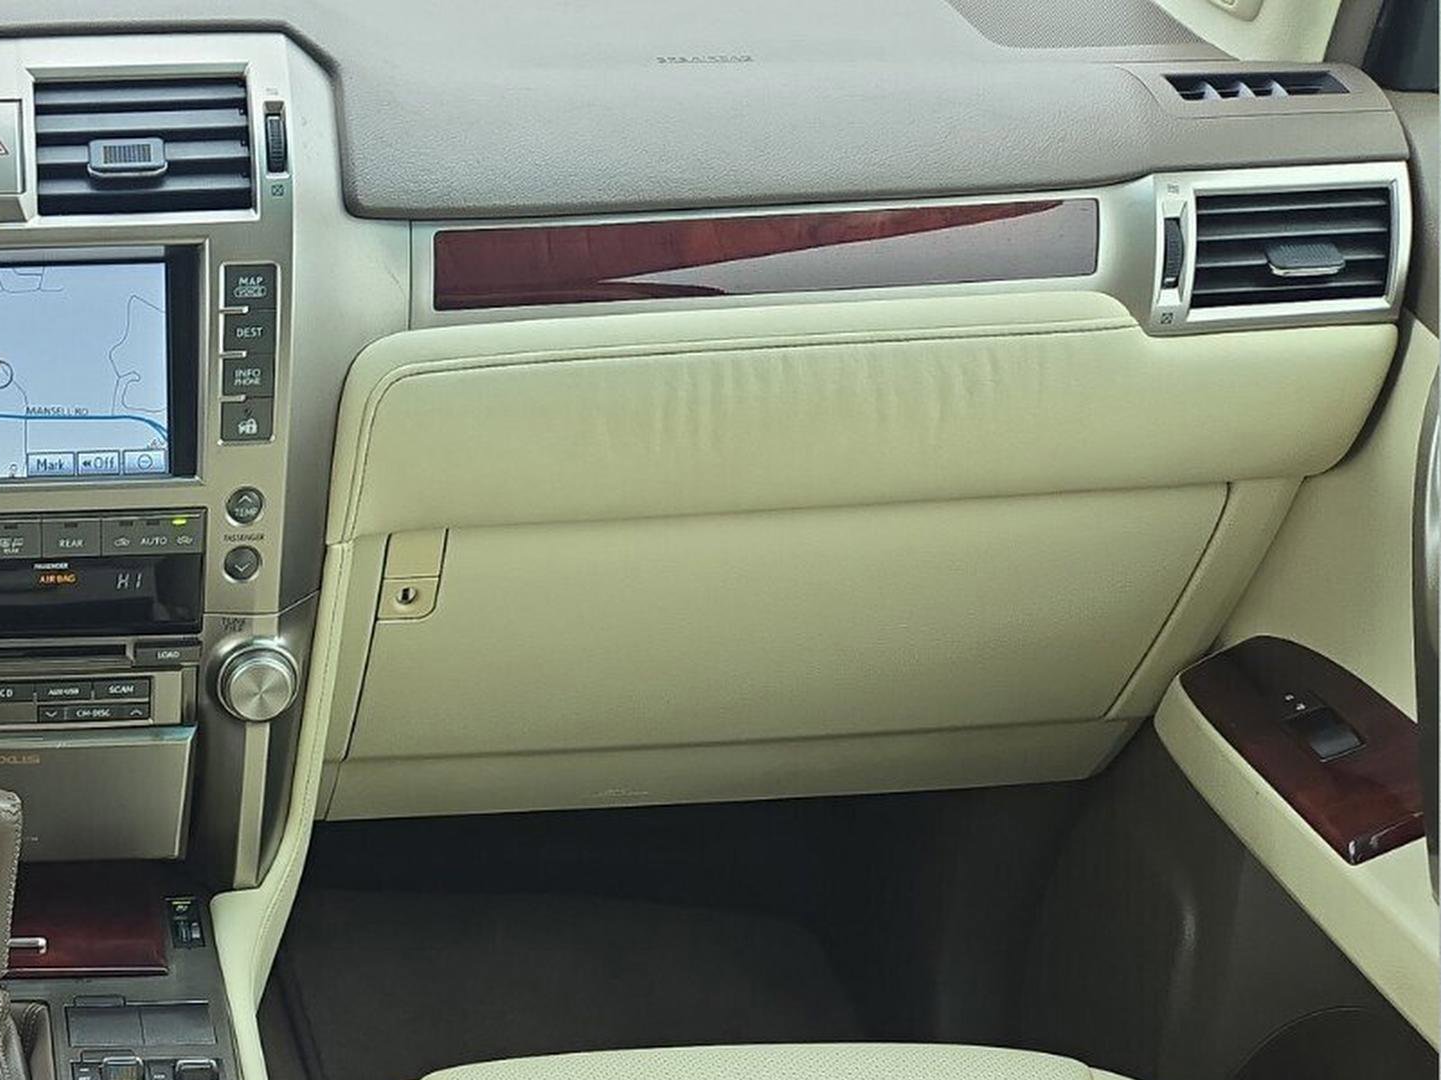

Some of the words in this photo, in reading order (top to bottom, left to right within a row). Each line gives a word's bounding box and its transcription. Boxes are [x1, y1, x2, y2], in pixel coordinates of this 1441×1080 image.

[239, 277, 263, 286] MAP
[236, 326, 264, 338] DEST
[234, 369, 261, 378] INFO
[36, 458, 65, 471] Mark
[94, 456, 115, 470] Off
[140, 536, 168, 546] AUTO
[157, 650, 181, 660] LOAD
[0, 688, 14, 698] CD
